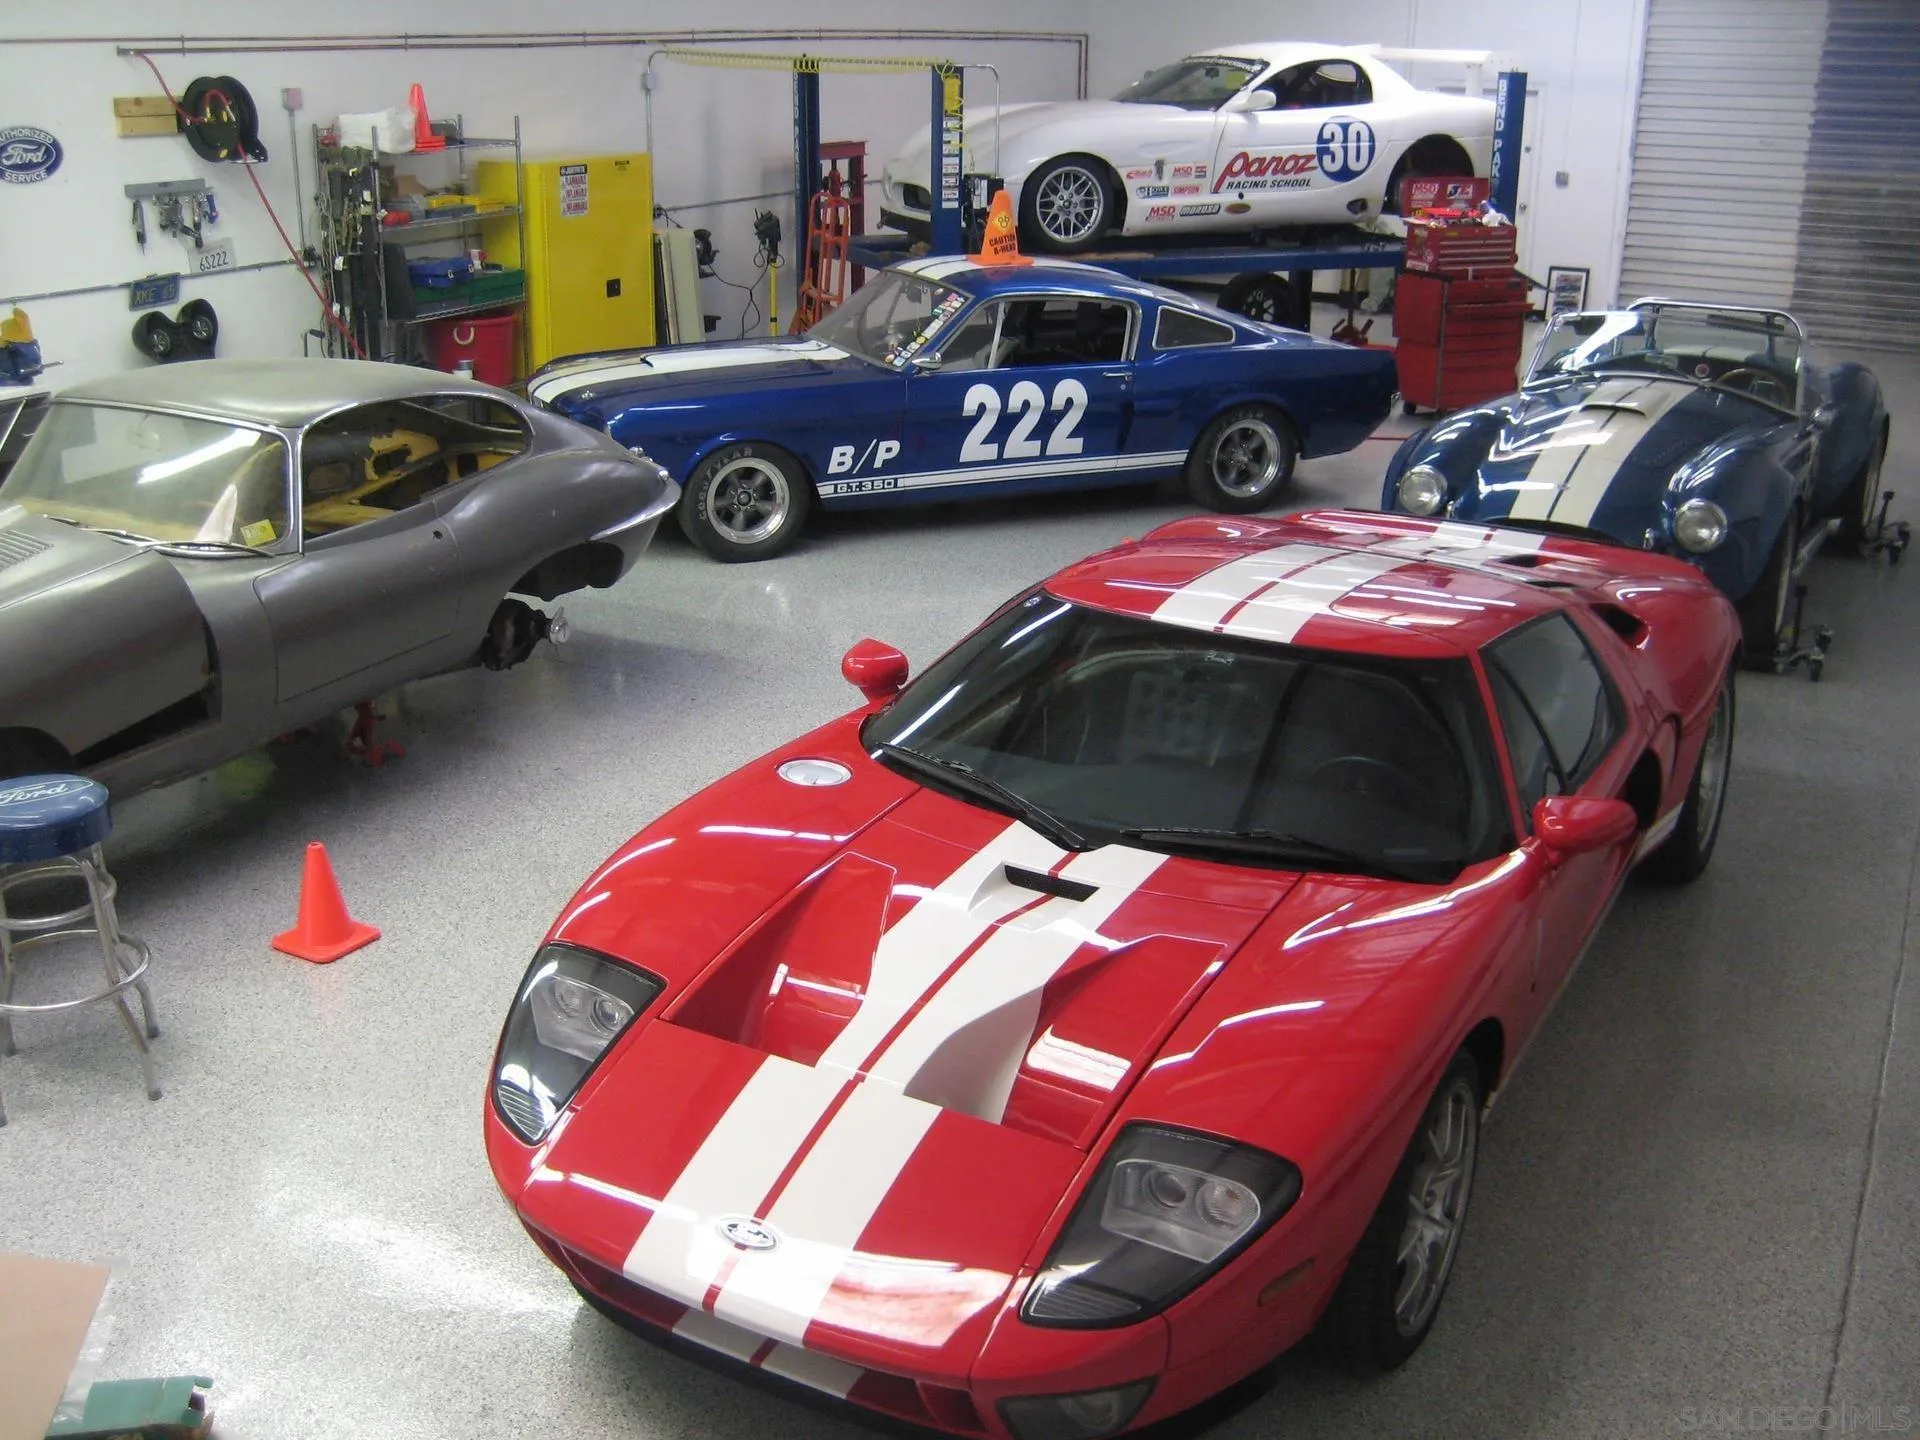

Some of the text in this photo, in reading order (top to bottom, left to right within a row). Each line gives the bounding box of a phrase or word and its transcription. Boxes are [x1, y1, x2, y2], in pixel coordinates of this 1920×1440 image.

[0, 128, 54, 144] UTHORIZED
[1491, 79, 1508, 178] BEND PAK
[2, 144, 47, 165] Ford
[1322, 122, 1370, 172] 30
[4, 169, 48, 183] SERVICE
[1173, 166, 1193, 175] MSD
[1172, 185, 1201, 195] SIMPSON
[1226, 178, 1311, 190] RACING SCHOOL
[1150, 206, 1176, 217] MSD
[959, 379, 1088, 463] 222
[827, 439, 901, 474] B/P
[0, 783, 69, 804] Ford
